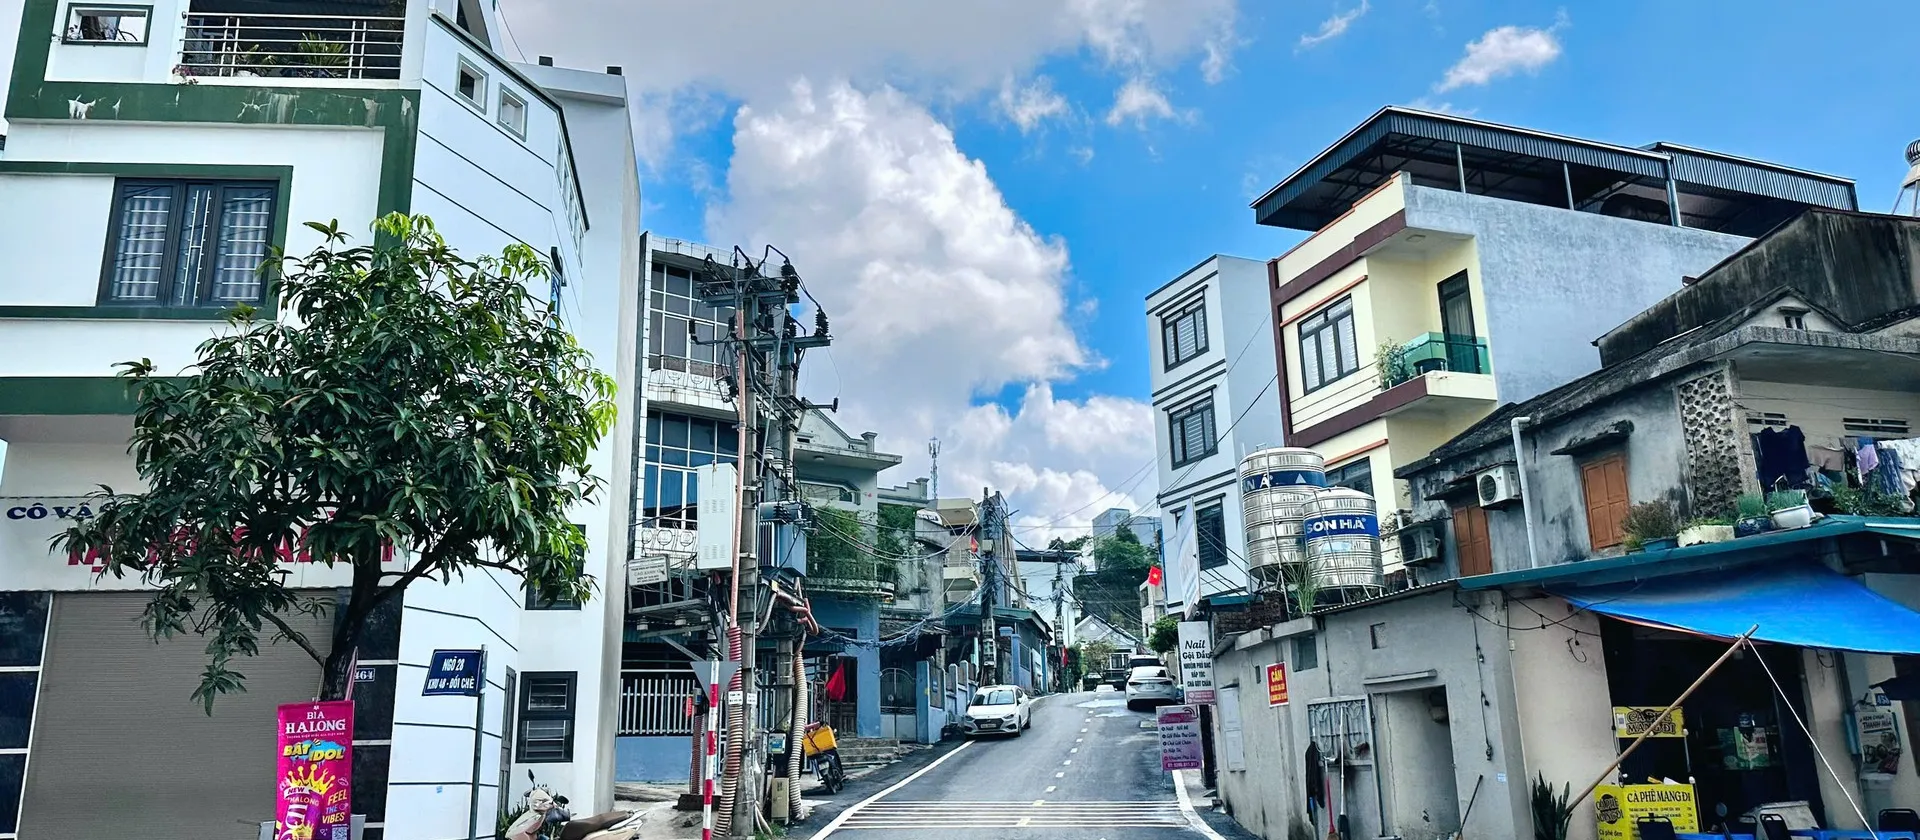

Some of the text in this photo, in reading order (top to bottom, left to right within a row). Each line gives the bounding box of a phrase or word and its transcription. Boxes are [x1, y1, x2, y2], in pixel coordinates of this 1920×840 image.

[7, 503, 48, 519] CÔ
[1339, 517, 1365, 530] HÀ
[1185, 640, 1206, 650] Nail
[1182, 652, 1195, 661] Gội
[456, 659, 465, 671] 28
[1271, 666, 1283, 683] CẤM
[461, 676, 475, 689] CHÈ
[307, 711, 325, 720] BIA
[285, 719, 346, 734] HALONG
[309, 748, 345, 761] IDOL
[328, 790, 347, 805] FEEL
[1627, 788, 1691, 803] CÀ PHÊ MANG ĐI
[326, 806, 338, 814] THE
[322, 812, 345, 824] VIBES
